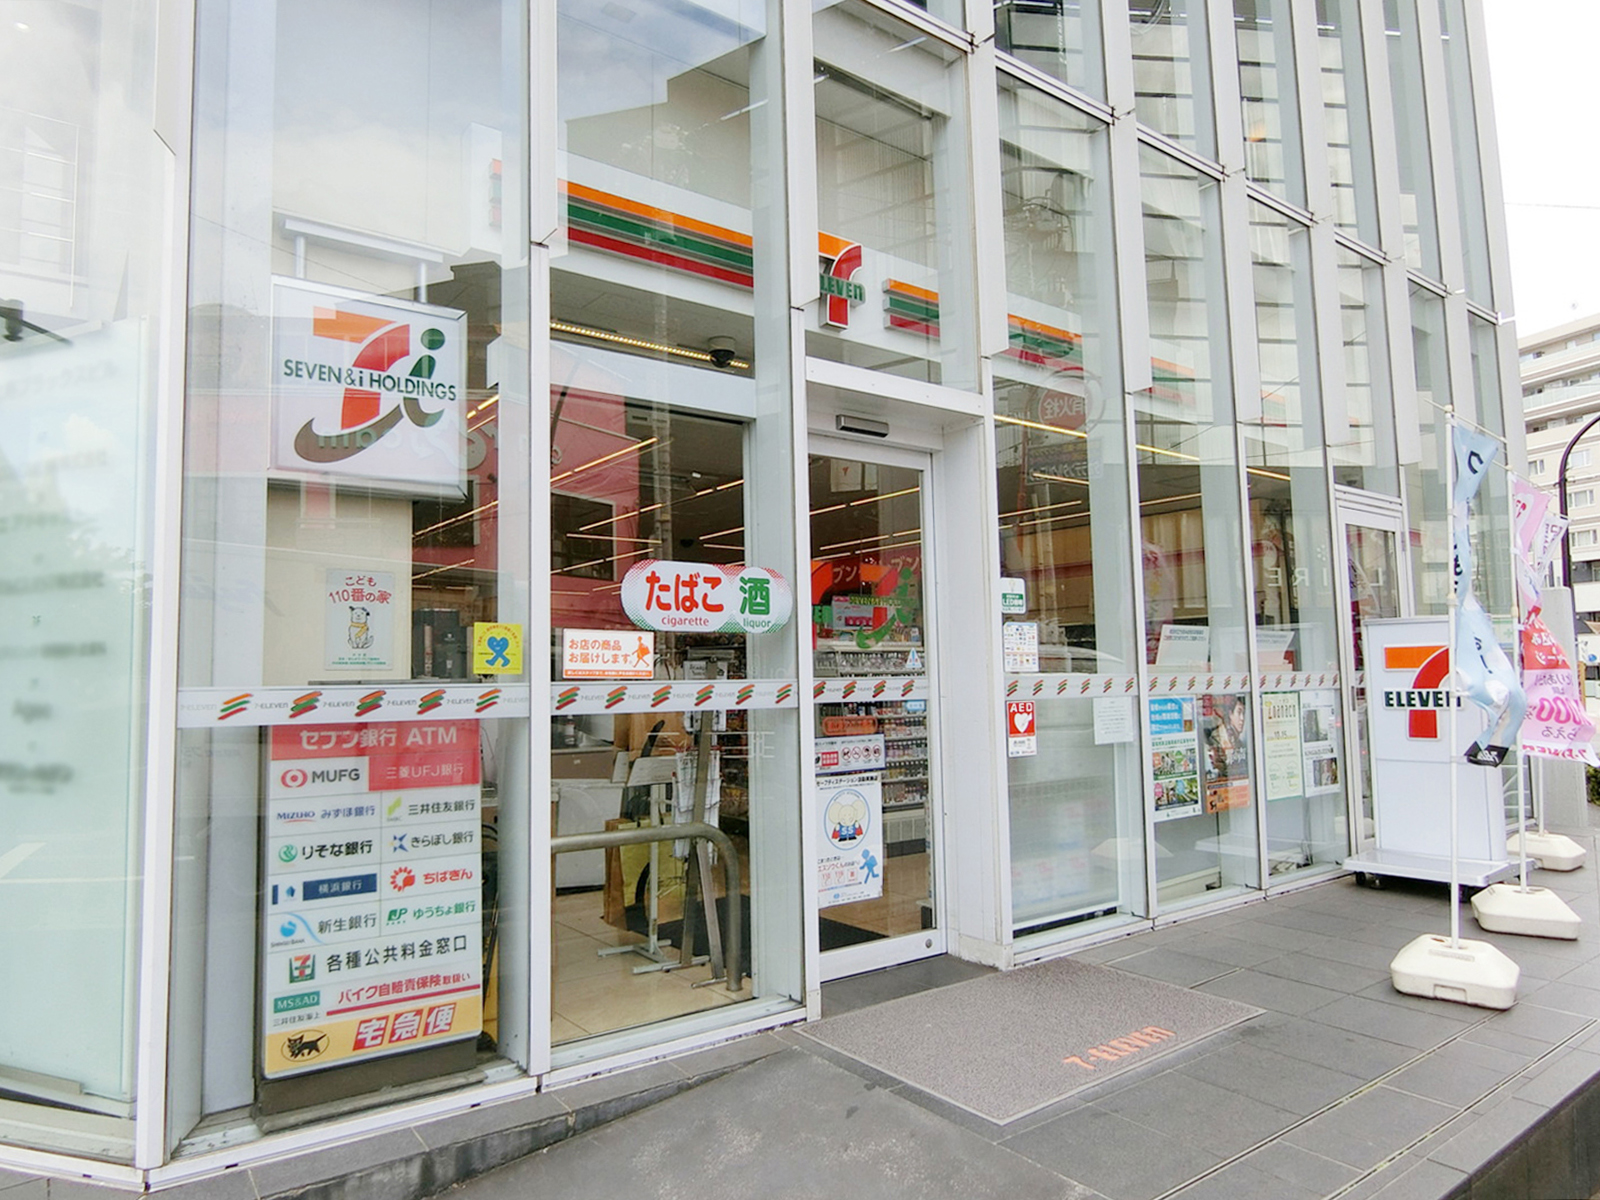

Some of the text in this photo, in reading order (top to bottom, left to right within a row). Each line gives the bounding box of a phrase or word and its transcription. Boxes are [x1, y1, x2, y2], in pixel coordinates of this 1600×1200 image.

[369, 373, 456, 402] HOLDINGS
[345, 575, 377, 587] こども
[329, 588, 392, 604] 110番の家
[645, 570, 724, 613] たばこ
[739, 576, 771, 616] 酒
[661, 616, 709, 627] cigarette
[743, 618, 771, 629] liquor
[568, 639, 622, 651] お店の商品
[1010, 702, 1033, 712] AED
[300, 726, 457, 750] セブン銀行 ATM
[312, 768, 360, 784] MUFG
[386, 763, 464, 780] 三菱UFJ銀行
[320, 805, 376, 820] みずほ銀行
[408, 799, 475, 816] 三井住友銀行
[410, 830, 474, 848] きらぼし銀行
[302, 840, 373, 860] りそな銀行
[423, 868, 473, 885] ちばぎん
[318, 881, 363, 895] 横浜銀行
[412, 900, 476, 920] ゆうちょ銀行
[318, 913, 377, 935] 新生銀行
[326, 935, 468, 973] 各種公共料金窓口
[357, 1004, 455, 1047] 宅急便
